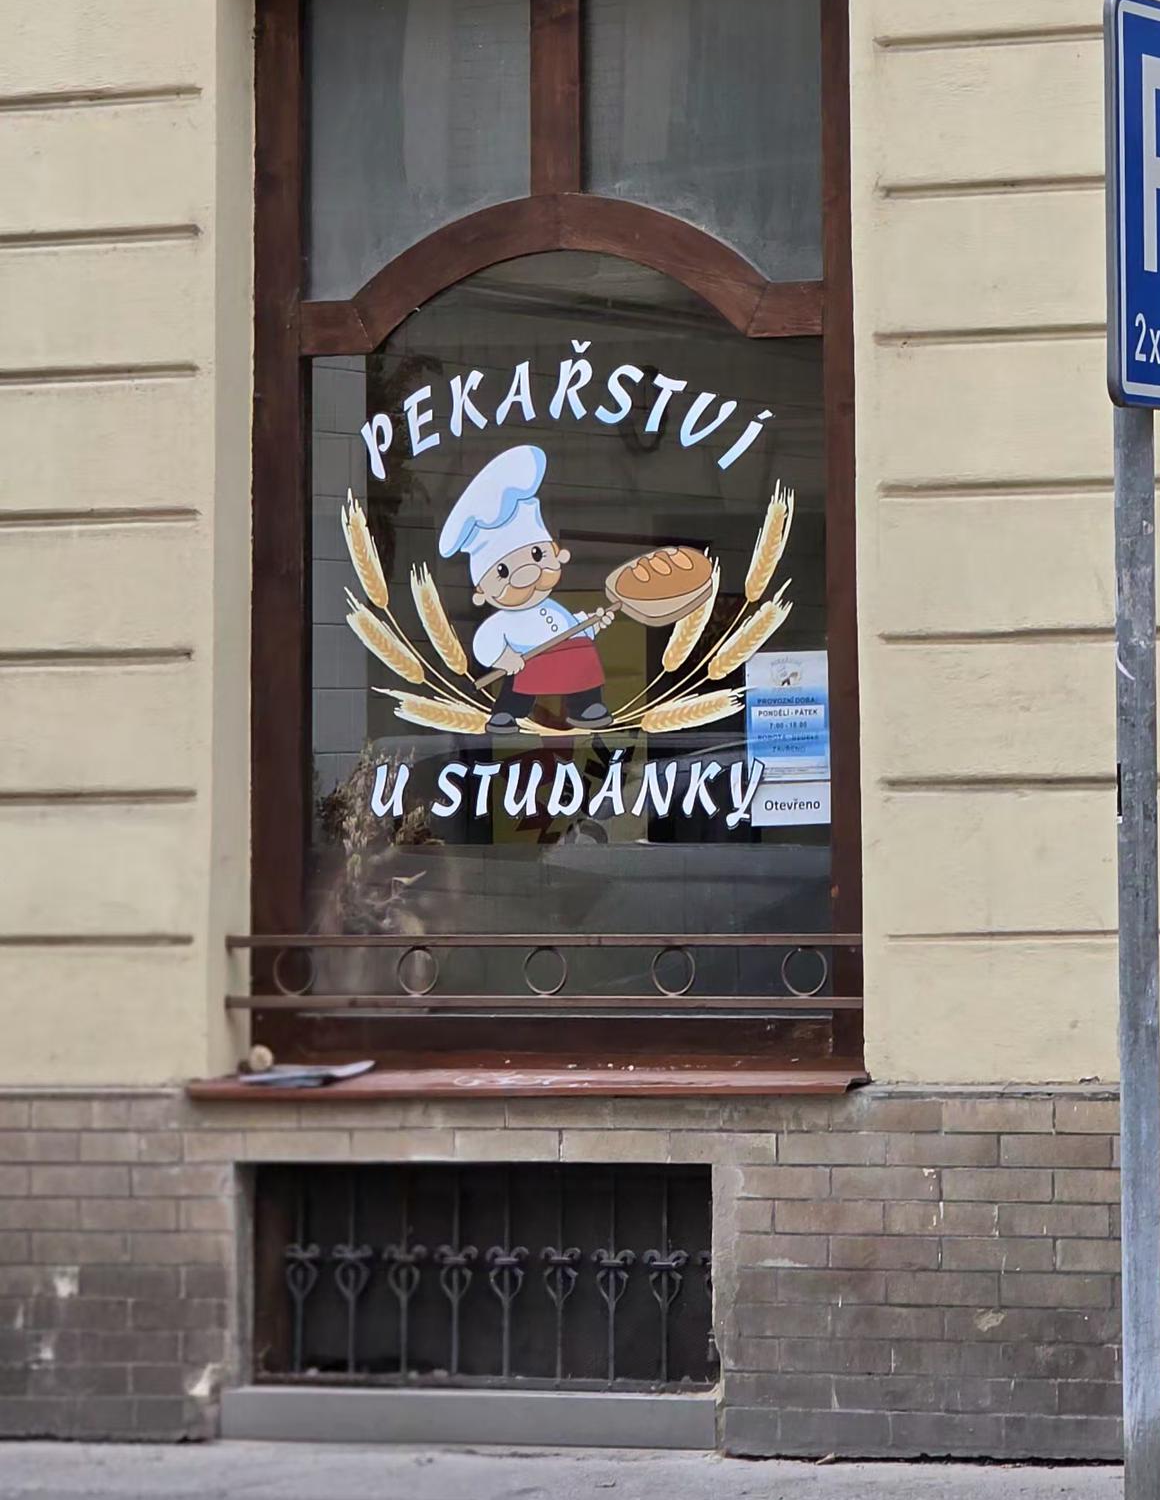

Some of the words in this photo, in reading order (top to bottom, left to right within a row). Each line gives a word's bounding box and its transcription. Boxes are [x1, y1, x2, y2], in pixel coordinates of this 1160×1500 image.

[360, 339, 774, 481] PEKAŘSTVÍ
[758, 708, 790, 717] PONDĚLÍ
[794, 708, 818, 716] PÁTEK
[369, 762, 411, 819] U
[430, 749, 765, 830] STUDÁNKY
[764, 798, 821, 812] Otevřeno
